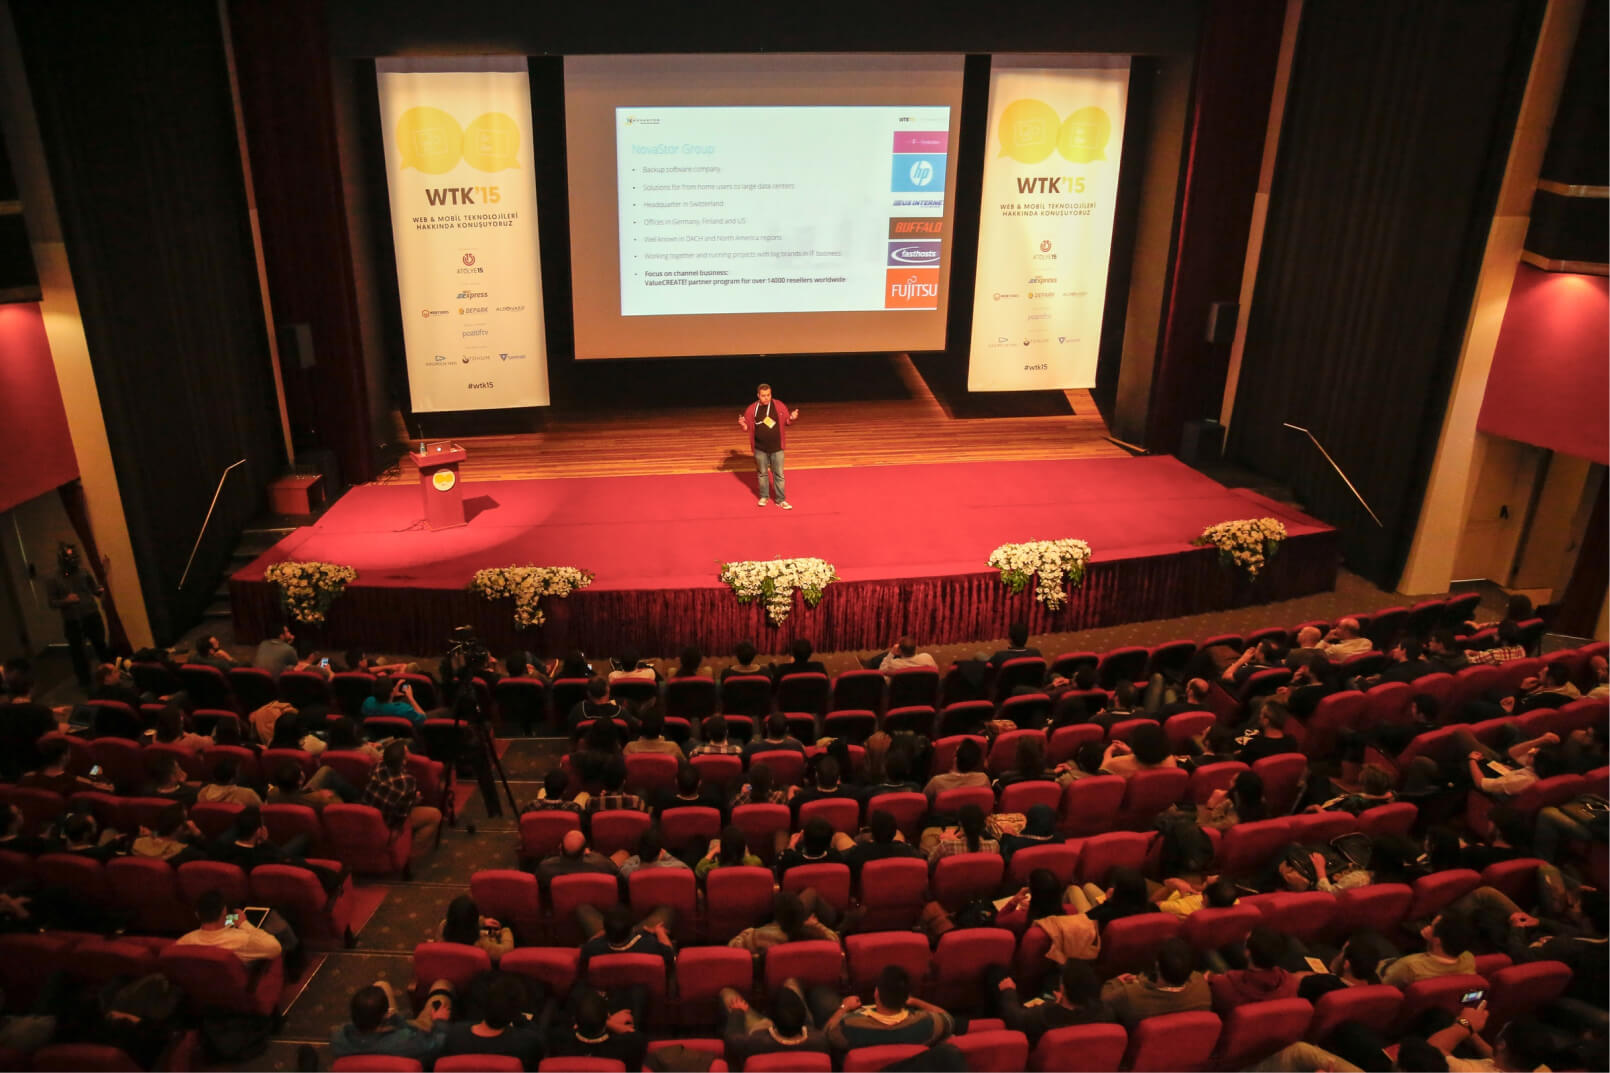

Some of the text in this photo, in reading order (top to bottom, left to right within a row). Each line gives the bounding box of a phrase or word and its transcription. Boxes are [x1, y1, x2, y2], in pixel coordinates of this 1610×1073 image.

[1016, 176, 1086, 194] WTK'15
[425, 185, 501, 206] WTK'15
[895, 222, 944, 233] BUFFALO
[901, 247, 937, 258] fasthosts
[688, 279, 712, 287] partner
[713, 278, 740, 286] program
[891, 280, 939, 300] FUJITSU
[1024, 363, 1048, 371] #wtk15
[468, 381, 494, 389] #wtk15
